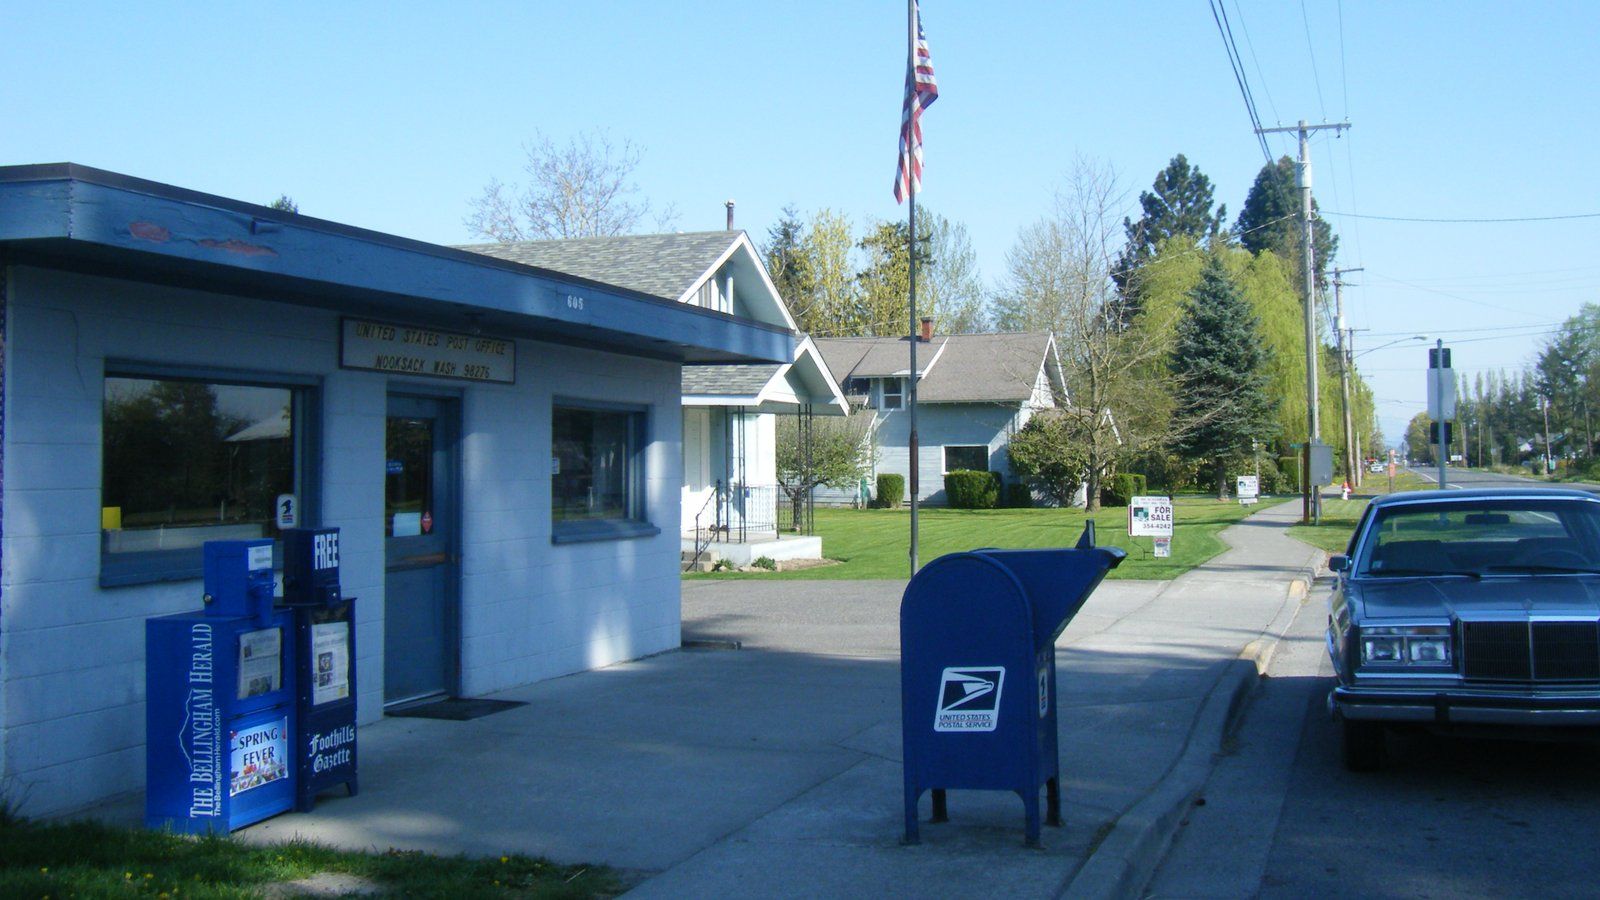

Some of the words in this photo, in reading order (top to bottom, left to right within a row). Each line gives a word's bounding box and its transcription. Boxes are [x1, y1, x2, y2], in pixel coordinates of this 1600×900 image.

[567, 294, 584, 311] 605
[357, 322, 396, 342] UNITED
[403, 329, 439, 348] STATES
[448, 336, 469, 352] POST
[475, 340, 507, 356] OFFICE
[375, 354, 425, 373] NOOKSACK
[433, 361, 457, 377] WASH
[1150, 513, 1171, 522] SALE
[1154, 506, 1171, 514] FOR
[314, 532, 339, 570] FREE
[189, 623, 213, 684] HERALD
[189, 688, 213, 783] BELLINGHAM
[239, 727, 278, 750] SPRING
[308, 725, 355, 758] Foothills
[243, 746, 275, 766] FEVER
[313, 748, 351, 774] Gazette
[189, 787, 214, 818] THE
